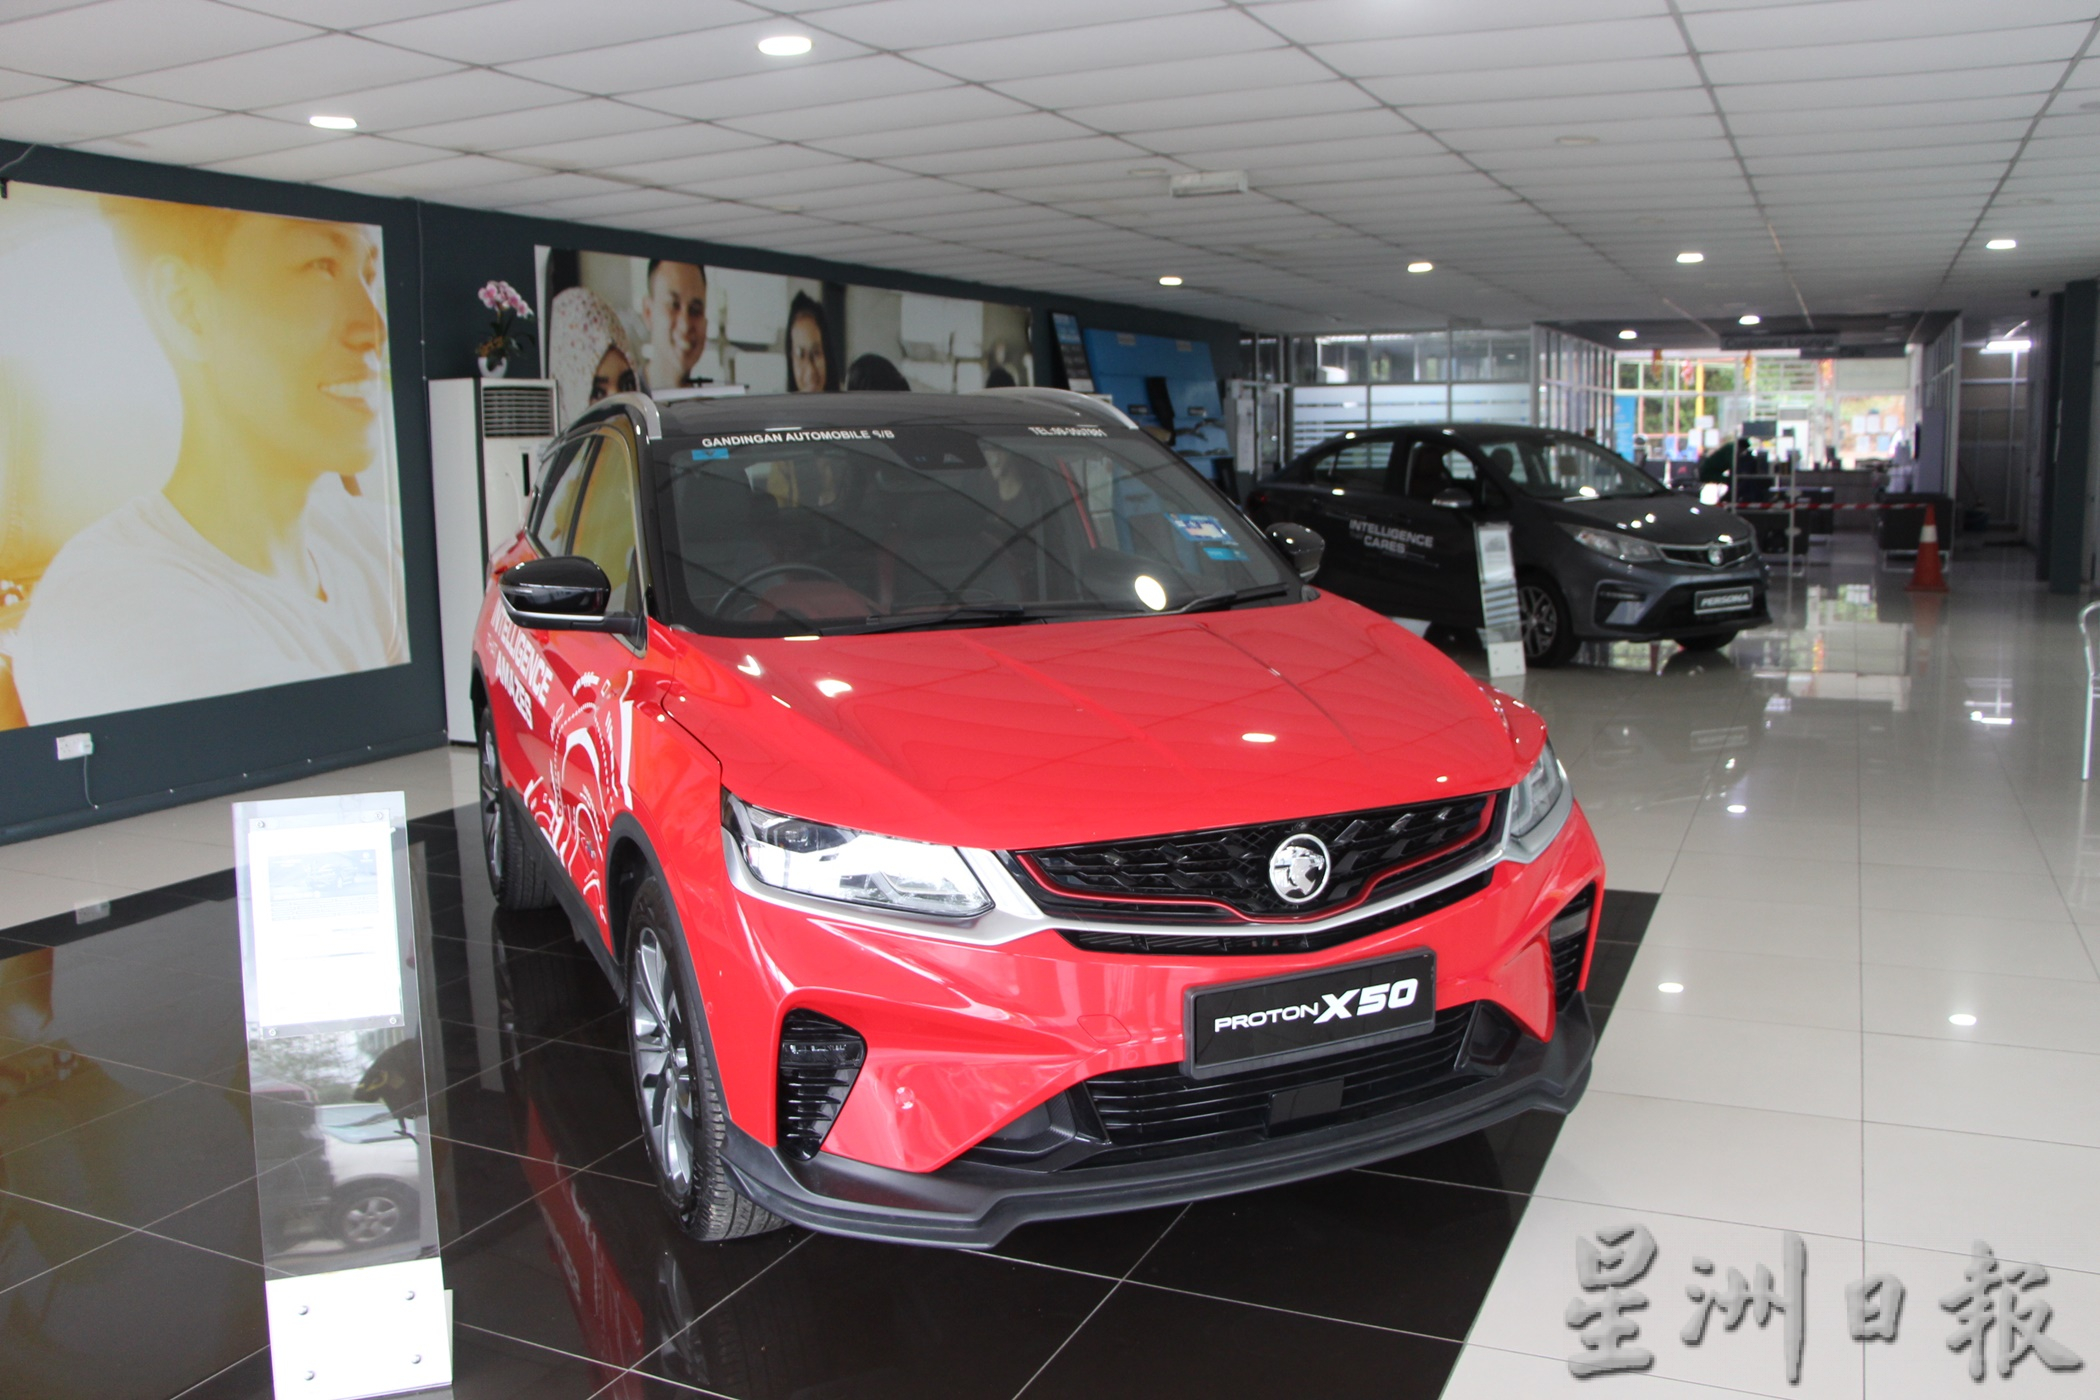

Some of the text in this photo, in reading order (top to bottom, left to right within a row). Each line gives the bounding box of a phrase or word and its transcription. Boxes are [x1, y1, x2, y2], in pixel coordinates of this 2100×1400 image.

[702, 433, 783, 447] GANDINGAN
[786, 430, 871, 442] AUTOMOBILE
[1349, 519, 1434, 548] INTELLIGENCE
[1363, 535, 1406, 554] CARES
[1701, 592, 1750, 607] PERSONA
[490, 597, 554, 707] INTELLIGENCE
[495, 649, 534, 730] AMAZES
[1214, 978, 1419, 1033] PROTON X50
